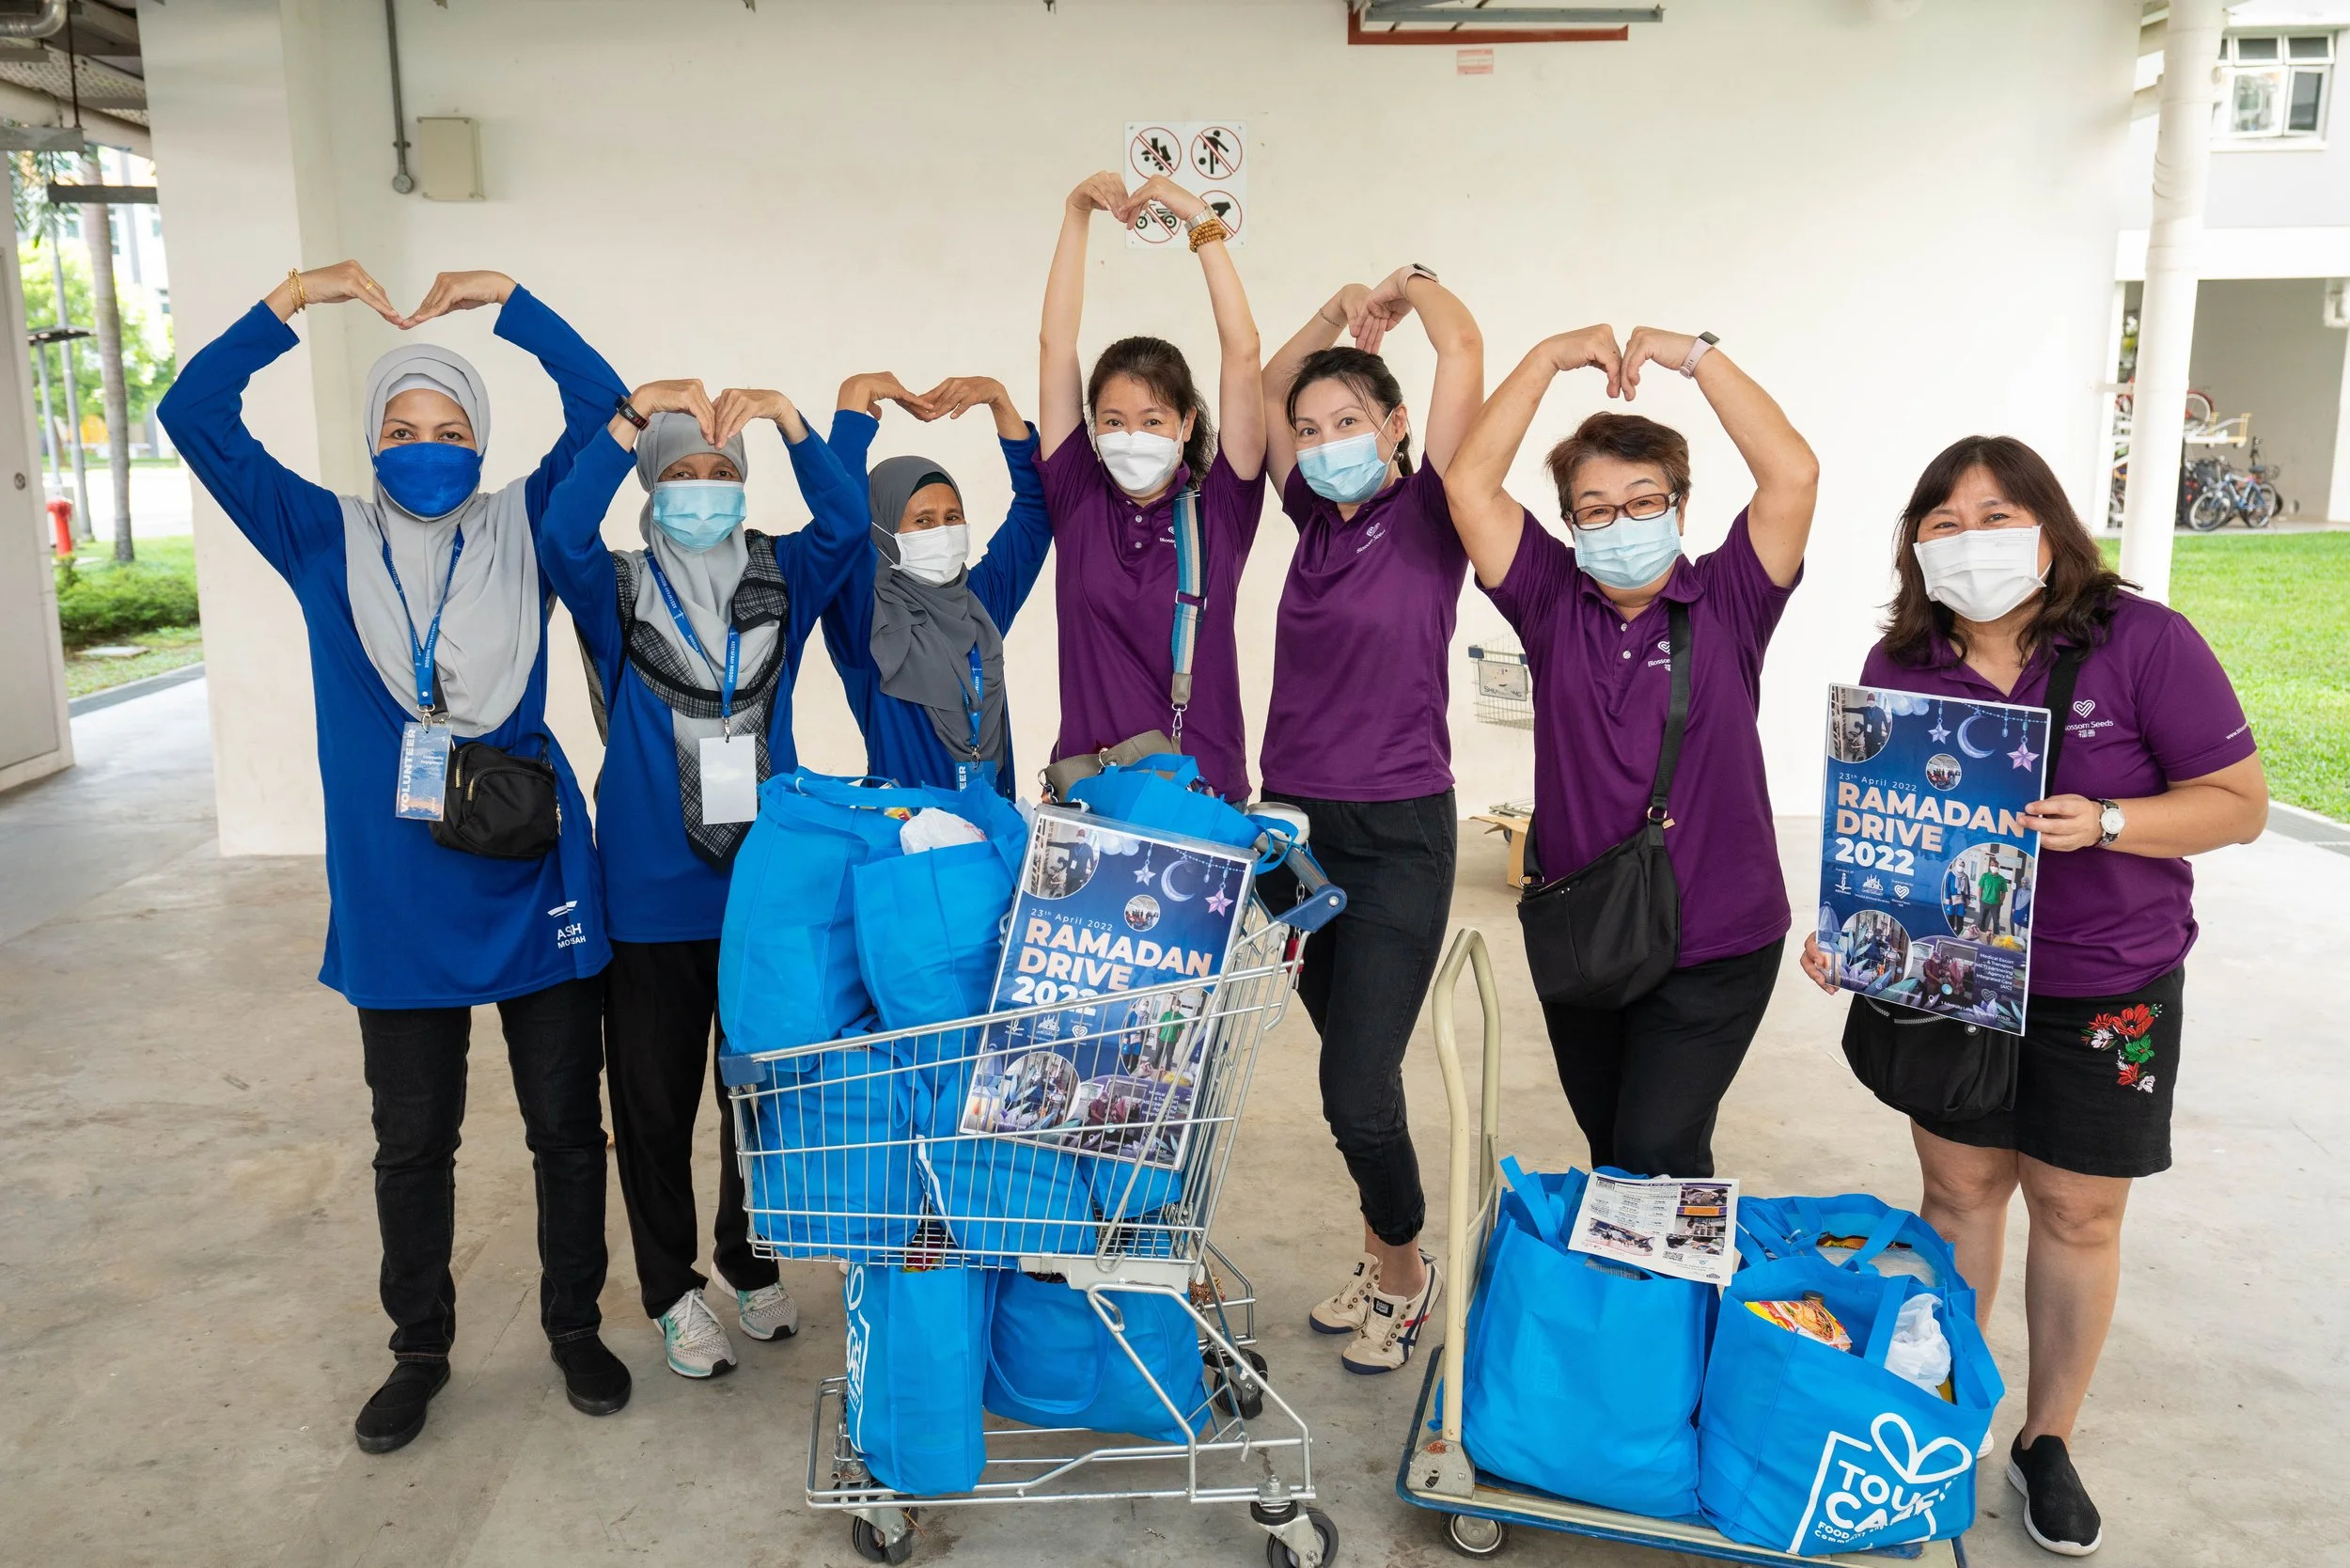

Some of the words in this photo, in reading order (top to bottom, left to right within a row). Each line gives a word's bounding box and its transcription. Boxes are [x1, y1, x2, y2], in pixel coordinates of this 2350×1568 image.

[2064, 723, 2091, 731] lossom
[400, 729, 415, 812] VOLUNTEER
[1861, 776, 1887, 787] April
[1892, 782, 1918, 792] 2022
[1837, 808, 1943, 854] DRIVE
[1838, 781, 2025, 839] RAMADAN
[1835, 837, 1915, 876] 2022
[1055, 912, 1083, 925] April
[1088, 919, 1113, 932] 2022
[1025, 917, 1213, 978] RAMADAN
[1018, 946, 1133, 992] DRIVE
[1818, 1521, 1850, 1540] FOOD
